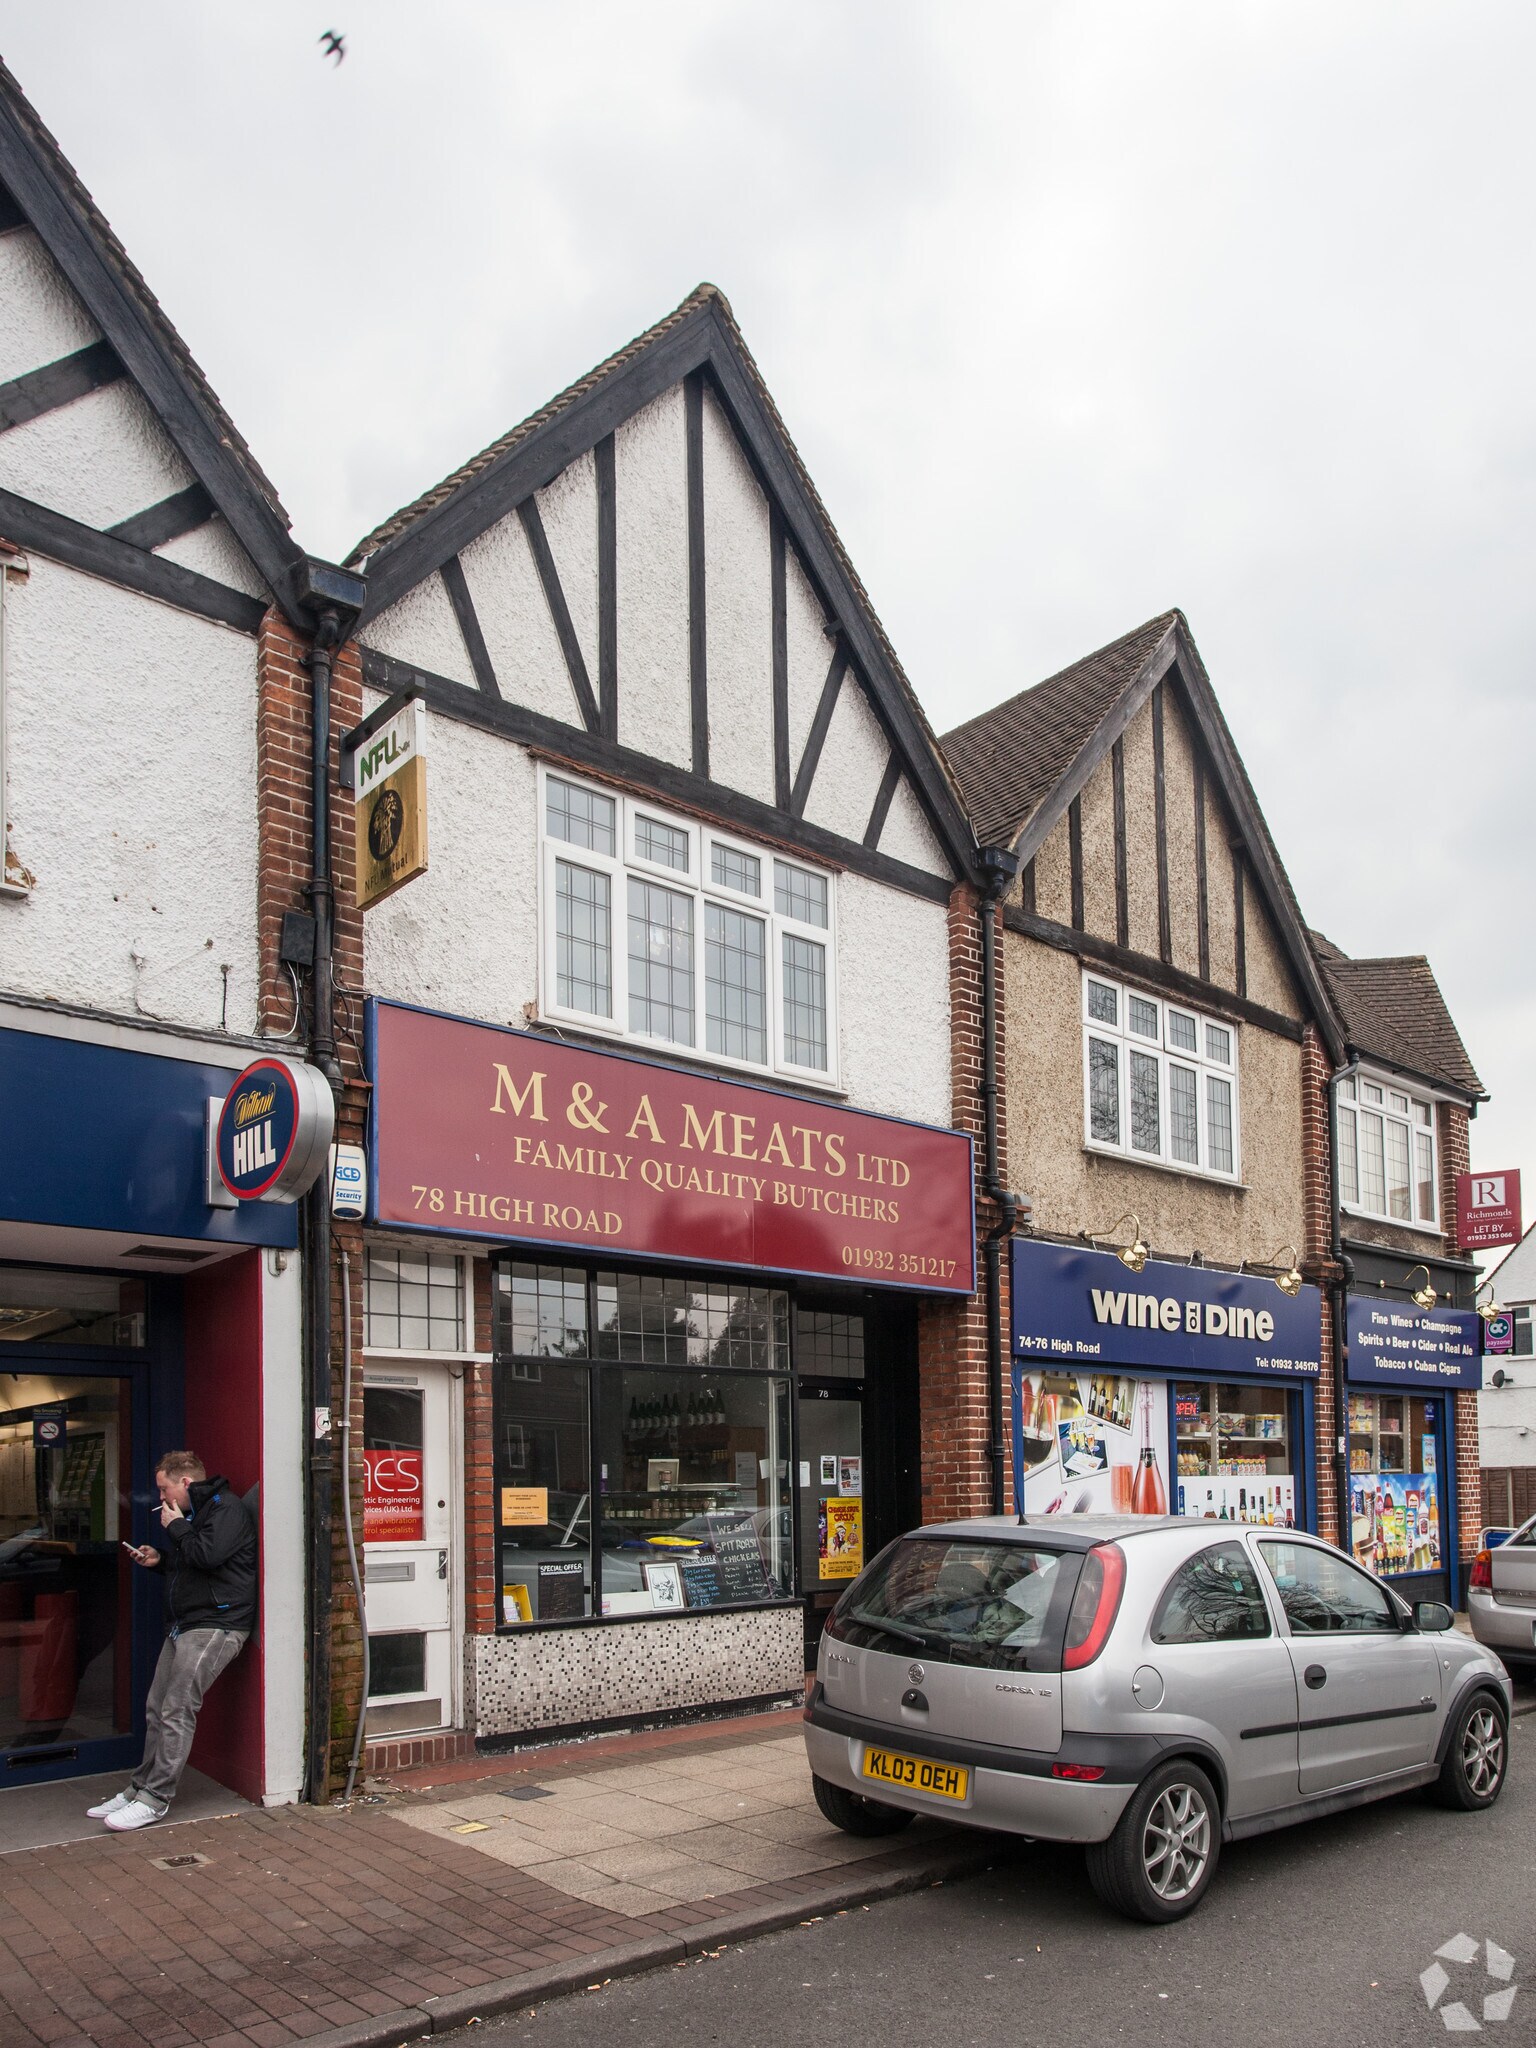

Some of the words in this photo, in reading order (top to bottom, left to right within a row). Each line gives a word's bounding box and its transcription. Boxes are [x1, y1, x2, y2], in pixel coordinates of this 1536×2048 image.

[361, 730, 400, 786] NFU
[234, 1082, 276, 1129] William
[489, 1062, 550, 1122] M
[566, 1081, 610, 1134] &
[625, 1094, 666, 1144] A
[679, 1103, 847, 1177] MEATS
[857, 1152, 911, 1187] LTD
[233, 1119, 276, 1178] HILL
[513, 1136, 634, 1181] FAMILY
[640, 1158, 767, 1202] QUALITY
[772, 1180, 900, 1224] BUTCHERS
[336, 1191, 362, 1200] Security
[1476, 1181, 1501, 1205] R
[411, 1184, 445, 1213] 78
[453, 1190, 535, 1225] HIGH
[542, 1203, 623, 1235] ROAD
[1466, 1208, 1512, 1220] Richmonds
[1474, 1224, 1490, 1234] LET
[1491, 1223, 1504, 1232] BY
[842, 1245, 895, 1270] 01932
[899, 1253, 957, 1278] 351217
[1371, 1311, 1388, 1325] Fine
[1390, 1314, 1413, 1328] Wines
[1421, 1318, 1462, 1335] Champagne
[1018, 1335, 1048, 1350] 74-76
[1051, 1338, 1073, 1354] High
[1076, 1341, 1101, 1354] Road
[1358, 1331, 1384, 1346] Spirits
[1392, 1336, 1410, 1349] Beer
[1418, 1339, 1437, 1352] Cider
[1444, 1342, 1461, 1354] Real
[1462, 1343, 1473, 1356] Ale
[1255, 1357, 1269, 1368] Tel:
[1270, 1358, 1292, 1370] 01932
[1294, 1360, 1319, 1372] 345176
[1374, 1355, 1406, 1370] Tobacco
[1414, 1359, 1437, 1372] Cuban
[1439, 1361, 1461, 1375] Cigars
[818, 1389, 829, 1398] 78
[377, 1496, 420, 1505] Engineering
[383, 1505, 400, 1514] (UK)
[401, 1505, 413, 1513] Ltd
[369, 1517, 383, 1525] and
[379, 1526, 415, 1535] specialists
[716, 1524, 732, 1535] WE
[734, 1523, 753, 1533] SELL
[715, 1539, 735, 1553] SPIT
[723, 1551, 761, 1564] CHICKENS
[540, 1564, 563, 1573] SPECIAL
[563, 1562, 583, 1571] OFFER
[995, 1683, 1036, 1695] CORSA
[870, 1751, 916, 1783] KL03
[920, 1763, 959, 1794] OEH
